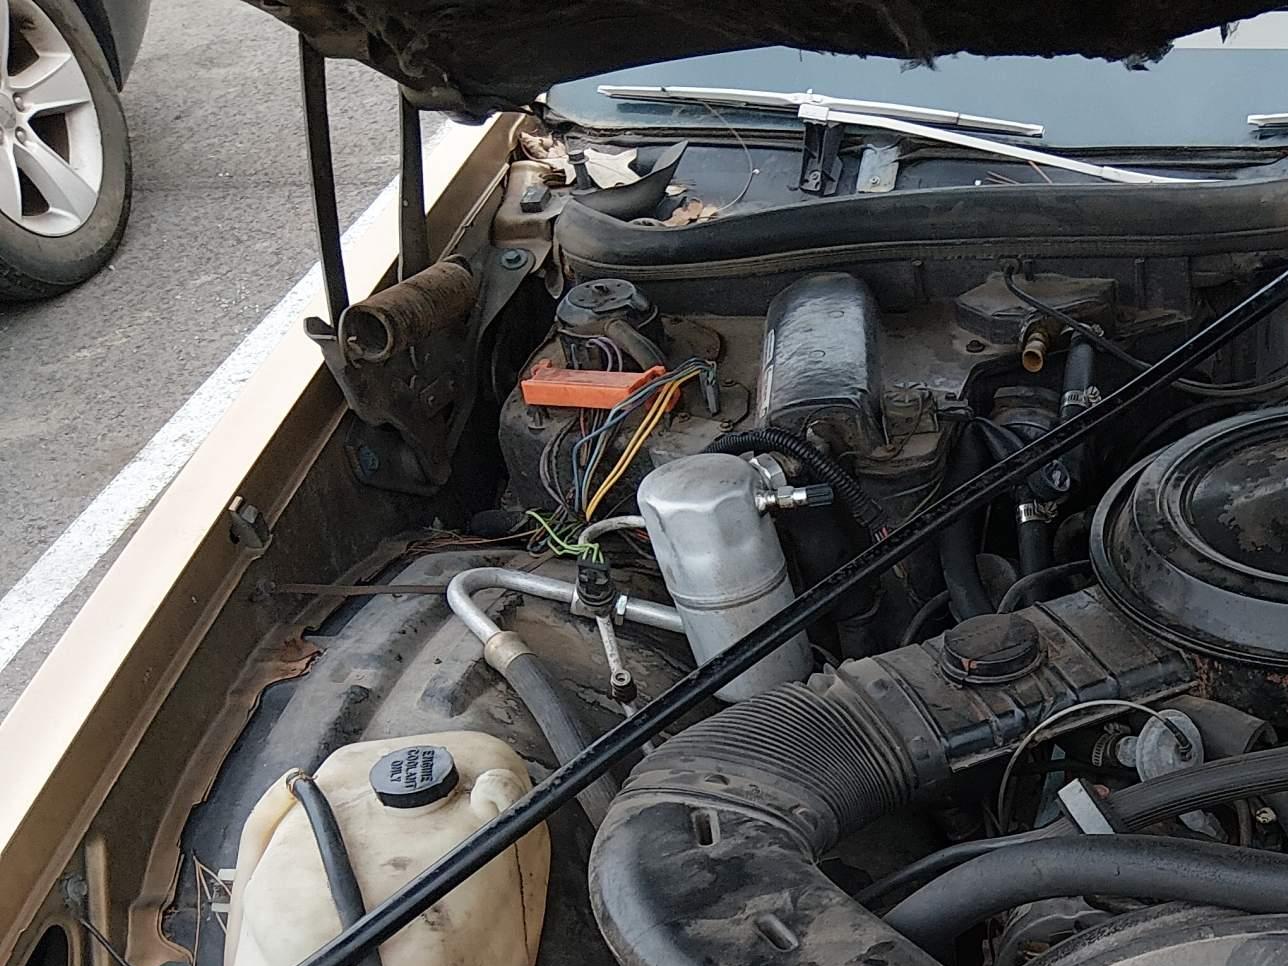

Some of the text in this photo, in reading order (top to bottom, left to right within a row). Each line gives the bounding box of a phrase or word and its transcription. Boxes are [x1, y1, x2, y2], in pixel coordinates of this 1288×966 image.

[390, 760, 404, 783] ONLY
[404, 749, 420, 789] COOLANT
[420, 749, 435, 783] ENGINE
